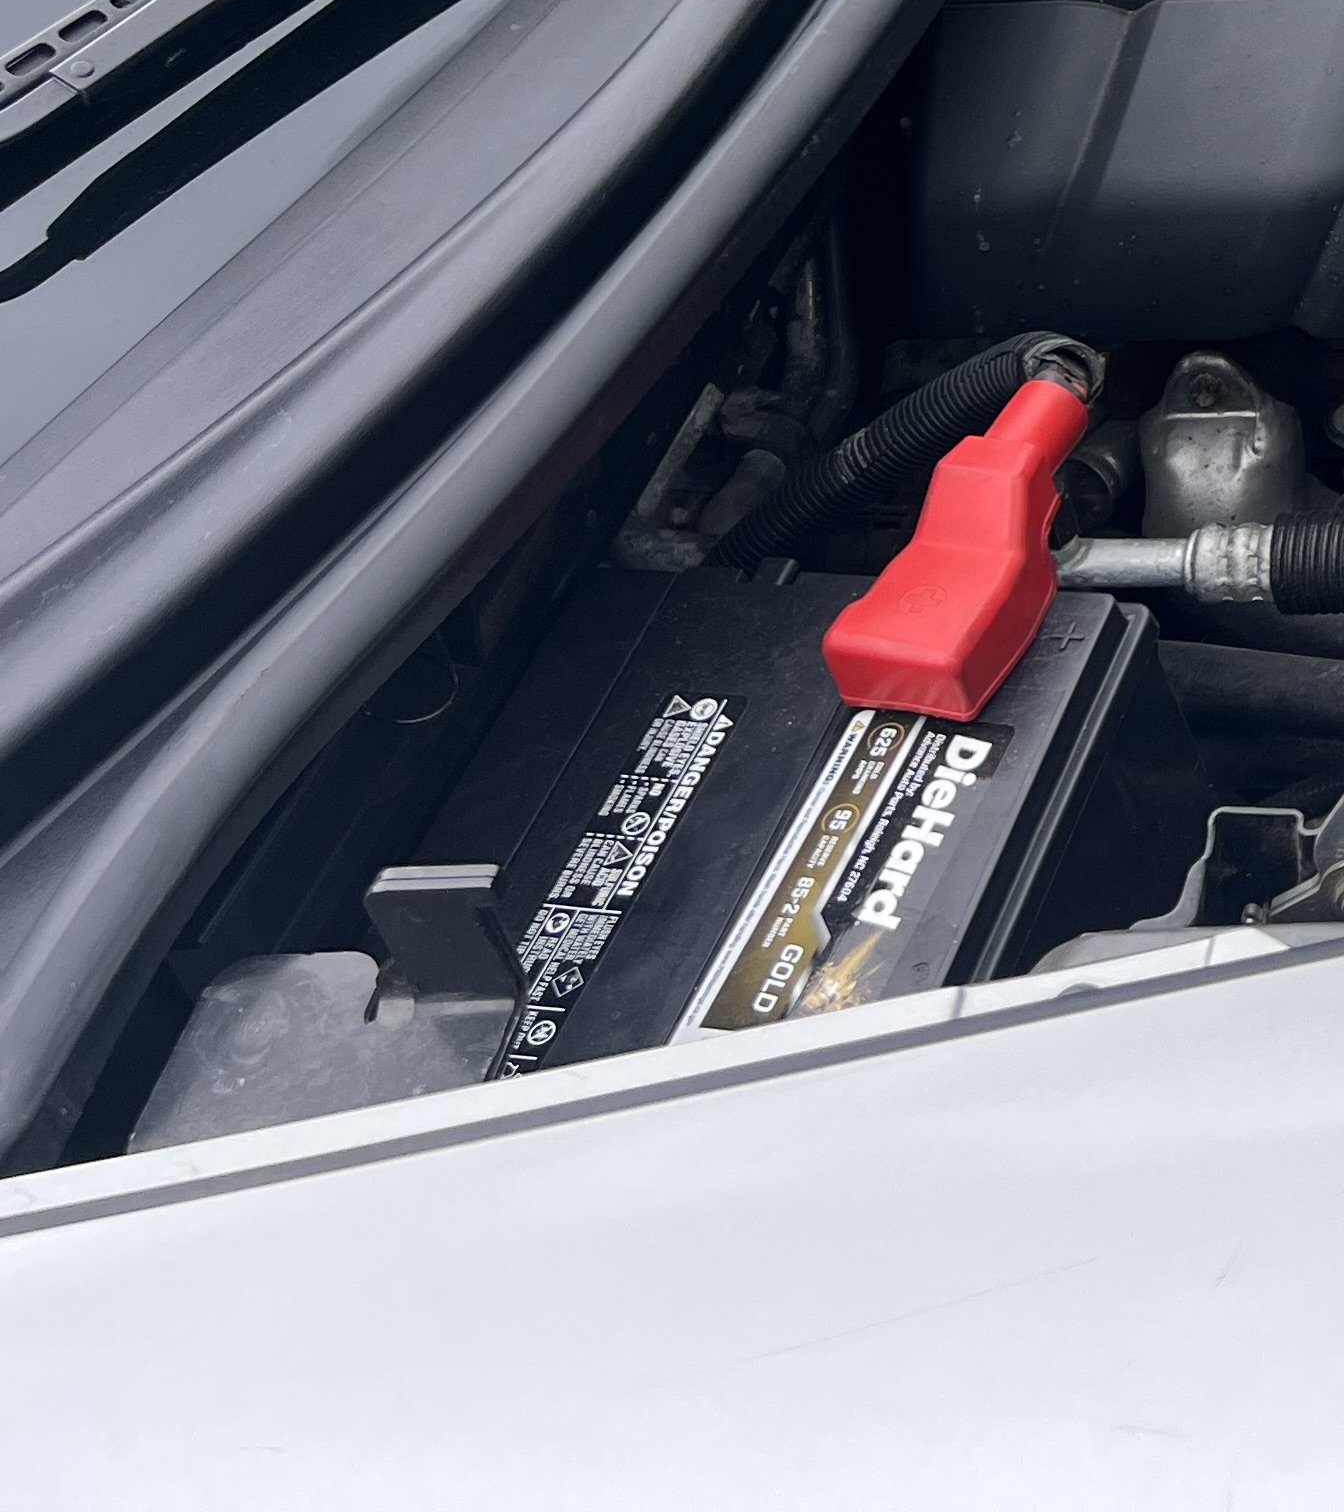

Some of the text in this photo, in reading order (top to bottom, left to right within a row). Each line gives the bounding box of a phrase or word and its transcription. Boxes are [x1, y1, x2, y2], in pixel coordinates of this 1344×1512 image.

[660, 720, 697, 768] EXPLOSIVE
[661, 719, 687, 748] GASES
[666, 721, 708, 778] SHIELD EYES.
[868, 726, 899, 757] 625
[821, 733, 858, 785] WARNING:
[850, 759, 868, 779] AMPS
[868, 761, 885, 779] COLD
[903, 733, 948, 797] Distributed by:
[647, 782, 665, 797] NO
[850, 760, 877, 794] CRANKING
[596, 783, 625, 817] SMOKING
[612, 785, 637, 813] FLAMES
[615, 730, 726, 896] DANGER/POISON
[624, 786, 649, 814] SPARKS
[827, 808, 853, 831] 95
[835, 731, 937, 902] Advance Auto Parts, Raleigh, NC 27604
[853, 734, 993, 930] DieHard
[579, 839, 614, 885] CAN CAUSE
[804, 834, 831, 868] CAPACITY
[815, 835, 839, 866] RESERVE
[545, 836, 592, 902] SEVERE BURNS.
[560, 837, 603, 898] BLINDNESS OR
[591, 867, 611, 887] ACID
[590, 867, 623, 907] SULFURIC
[779, 876, 814, 915] 85-2
[522, 922, 540, 940] NOT
[534, 908, 548, 922] DO
[571, 914, 587, 929] GET
[776, 917, 793, 936] PART
[537, 936, 558, 960] READ
[552, 928, 579, 961] MEDICAL
[561, 914, 598, 963] WITH WATER.
[571, 914, 608, 964] IMMEDIATELY
[584, 915, 619, 960] FLUSH EYES
[760, 916, 785, 948] NUMBER
[540, 960, 560, 982] HELP
[749, 942, 807, 1013] GOLD
[519, 1010, 539, 1031] KEEP
